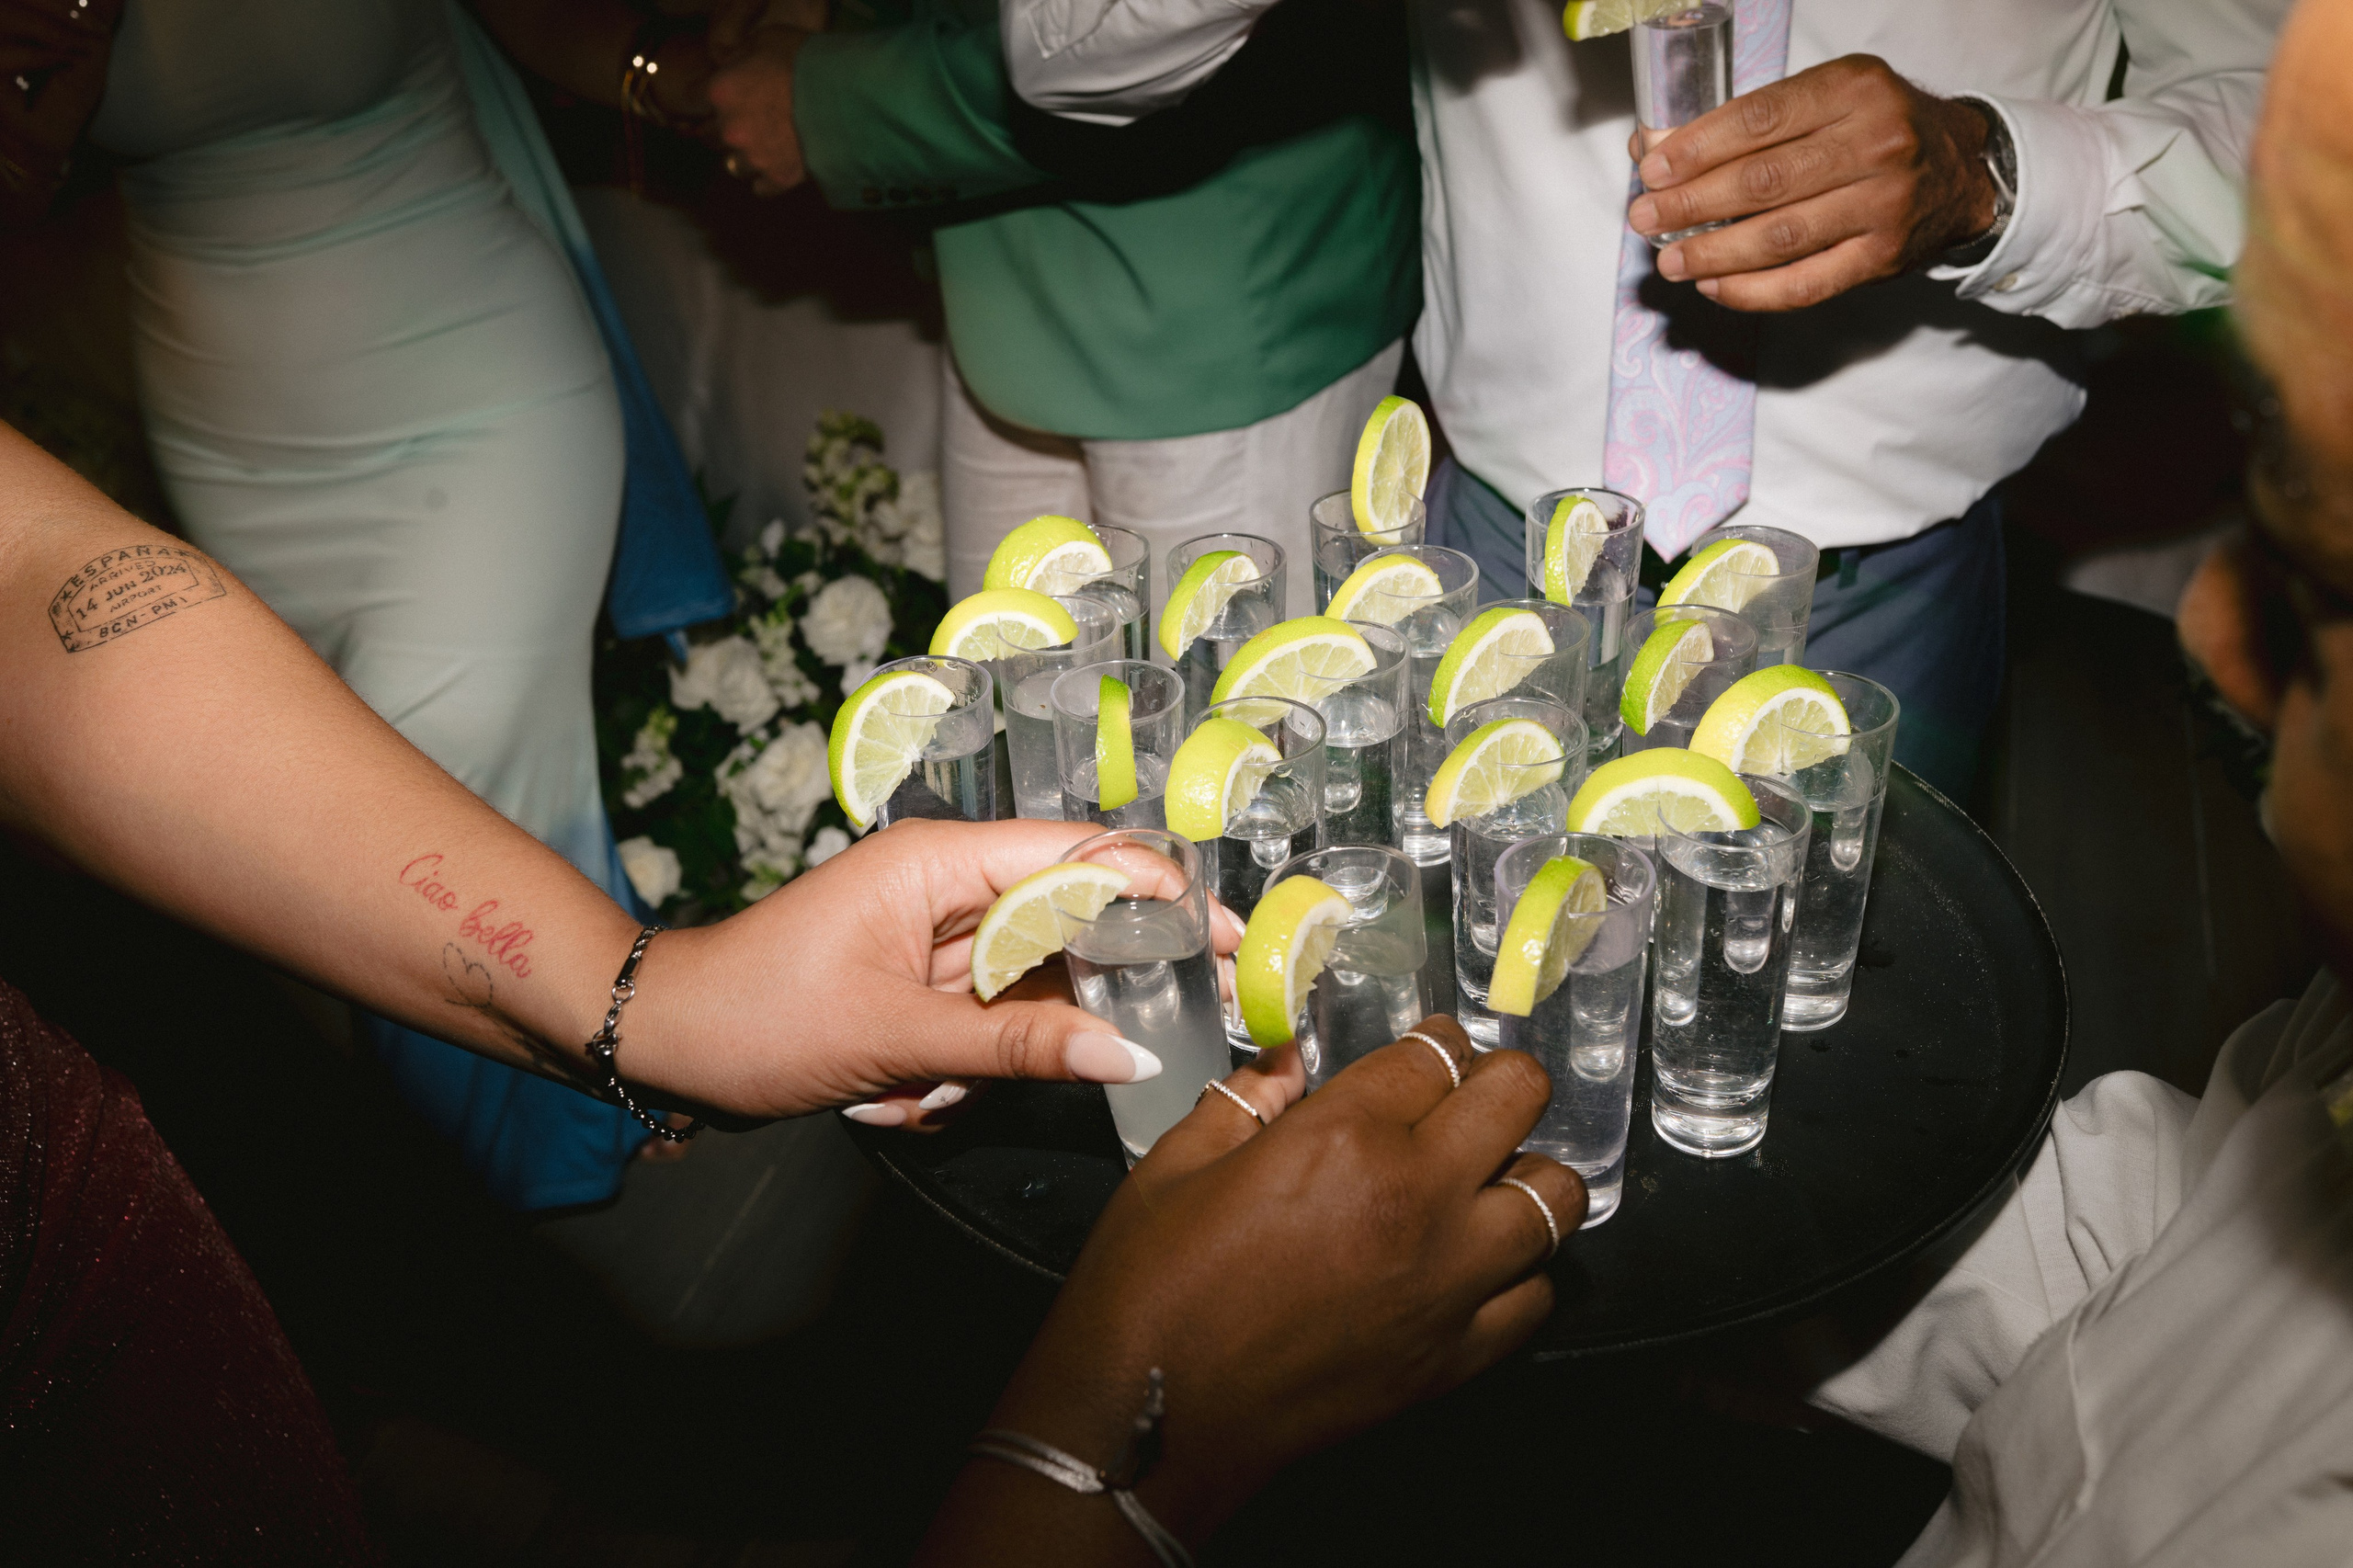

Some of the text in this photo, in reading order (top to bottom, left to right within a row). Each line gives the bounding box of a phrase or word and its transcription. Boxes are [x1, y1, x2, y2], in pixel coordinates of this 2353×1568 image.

[76, 562, 187, 619] 14 JUN 2024
[89, 560, 155, 592] ARRIVED
[109, 585, 162, 613] AIRPORT
[399, 854, 533, 979] Ciao bella
